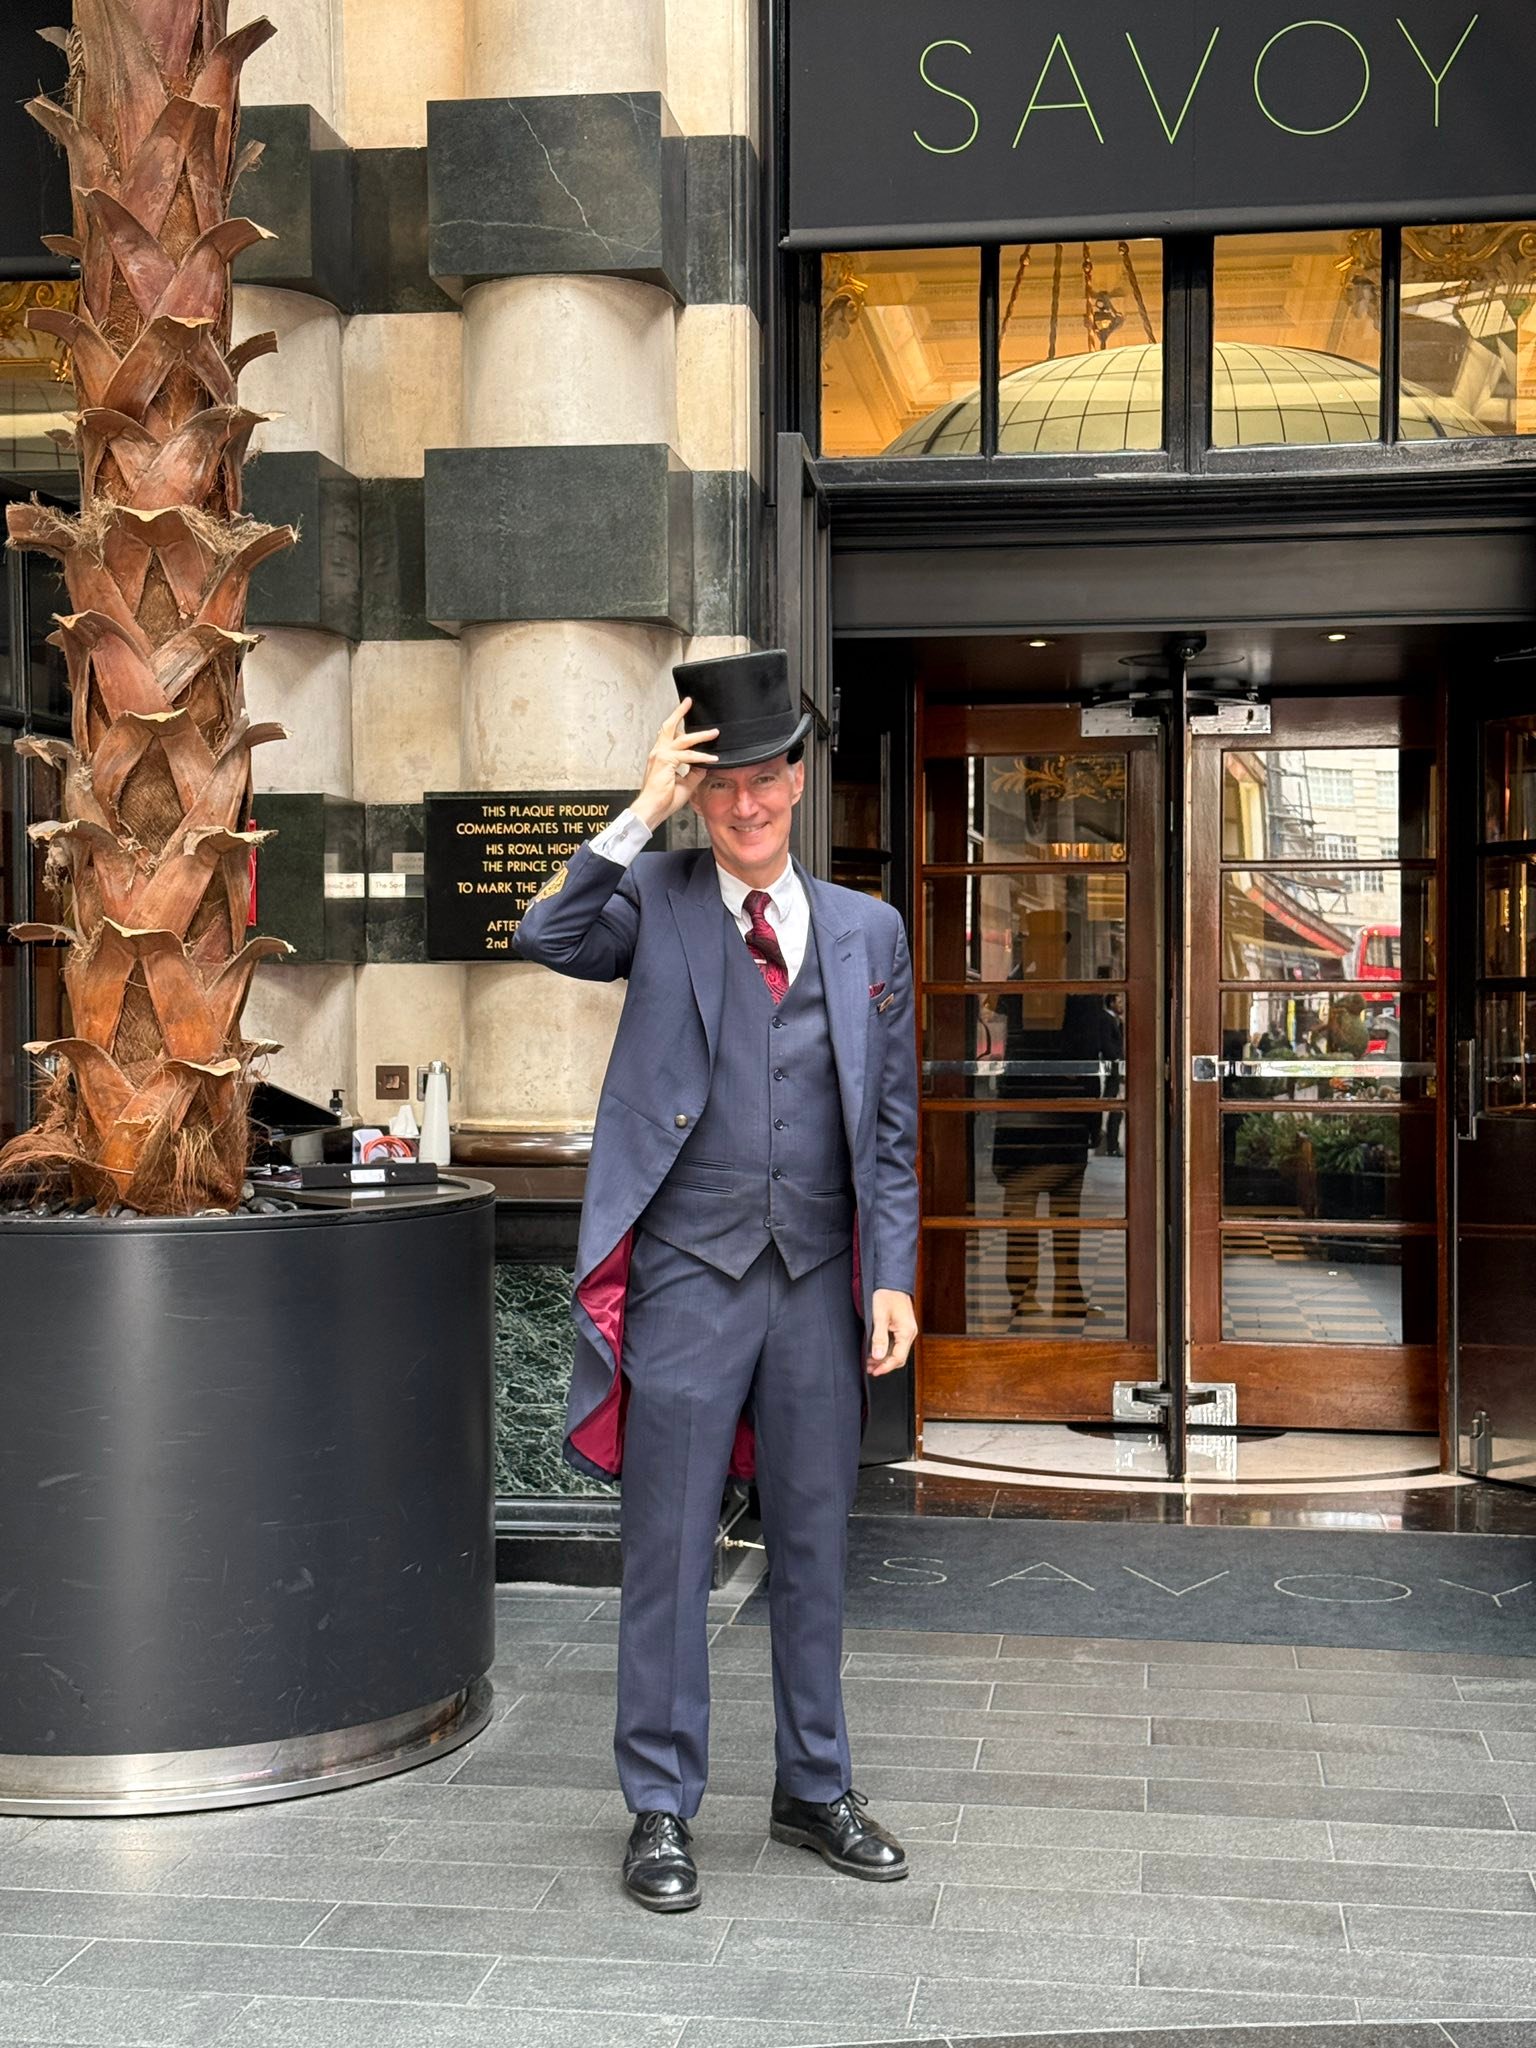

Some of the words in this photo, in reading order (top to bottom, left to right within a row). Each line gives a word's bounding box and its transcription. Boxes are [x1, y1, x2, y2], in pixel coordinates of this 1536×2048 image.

[912, 14, 1478, 154] SAVOY
[481, 805, 506, 817] THIS
[509, 805, 555, 818] PLAQUE
[559, 804, 610, 817] PROUDLY
[456, 822, 559, 835] COMMEMORATES
[562, 822, 584, 834] THE
[485, 843, 505, 855] HIS
[508, 843, 544, 855] ROYAL
[482, 860, 503, 872] THE
[507, 860, 548, 872] PRINCE
[456, 882, 474, 894] TO
[476, 882, 513, 894] MARK
[515, 881, 537, 894] THE
[515, 898, 530, 910] TH
[485, 937, 508, 949] 2nd
[868, 1556, 1533, 1607] SAVOY
